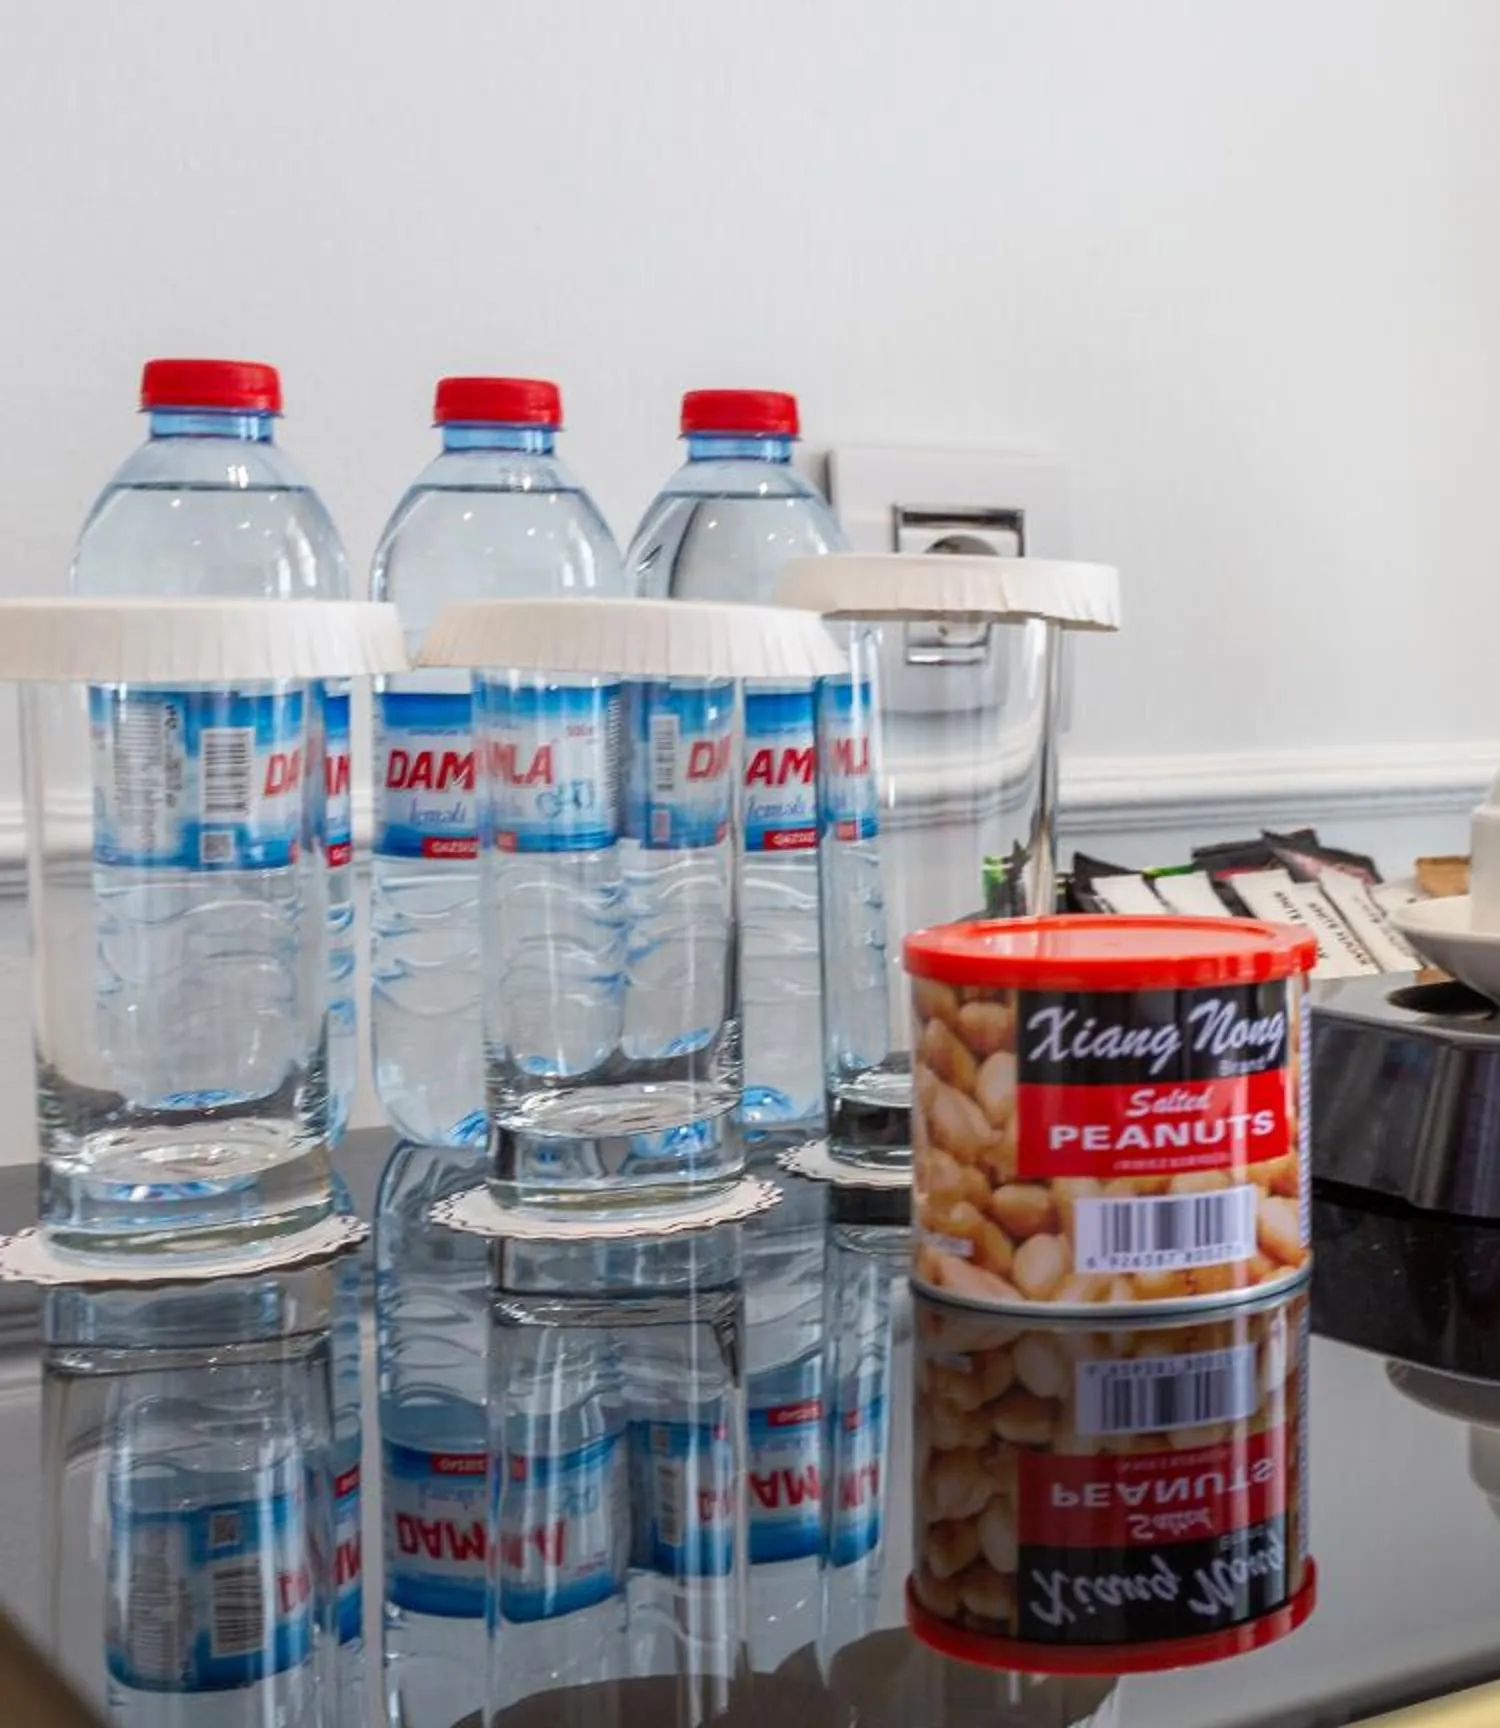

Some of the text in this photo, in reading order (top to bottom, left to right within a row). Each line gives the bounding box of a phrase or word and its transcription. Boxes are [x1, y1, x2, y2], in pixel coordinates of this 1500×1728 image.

[1026, 999, 1286, 1075] Xiang Nong
[1125, 1085, 1216, 1119] Salted
[1048, 1110, 1277, 1151] PEANUTS
